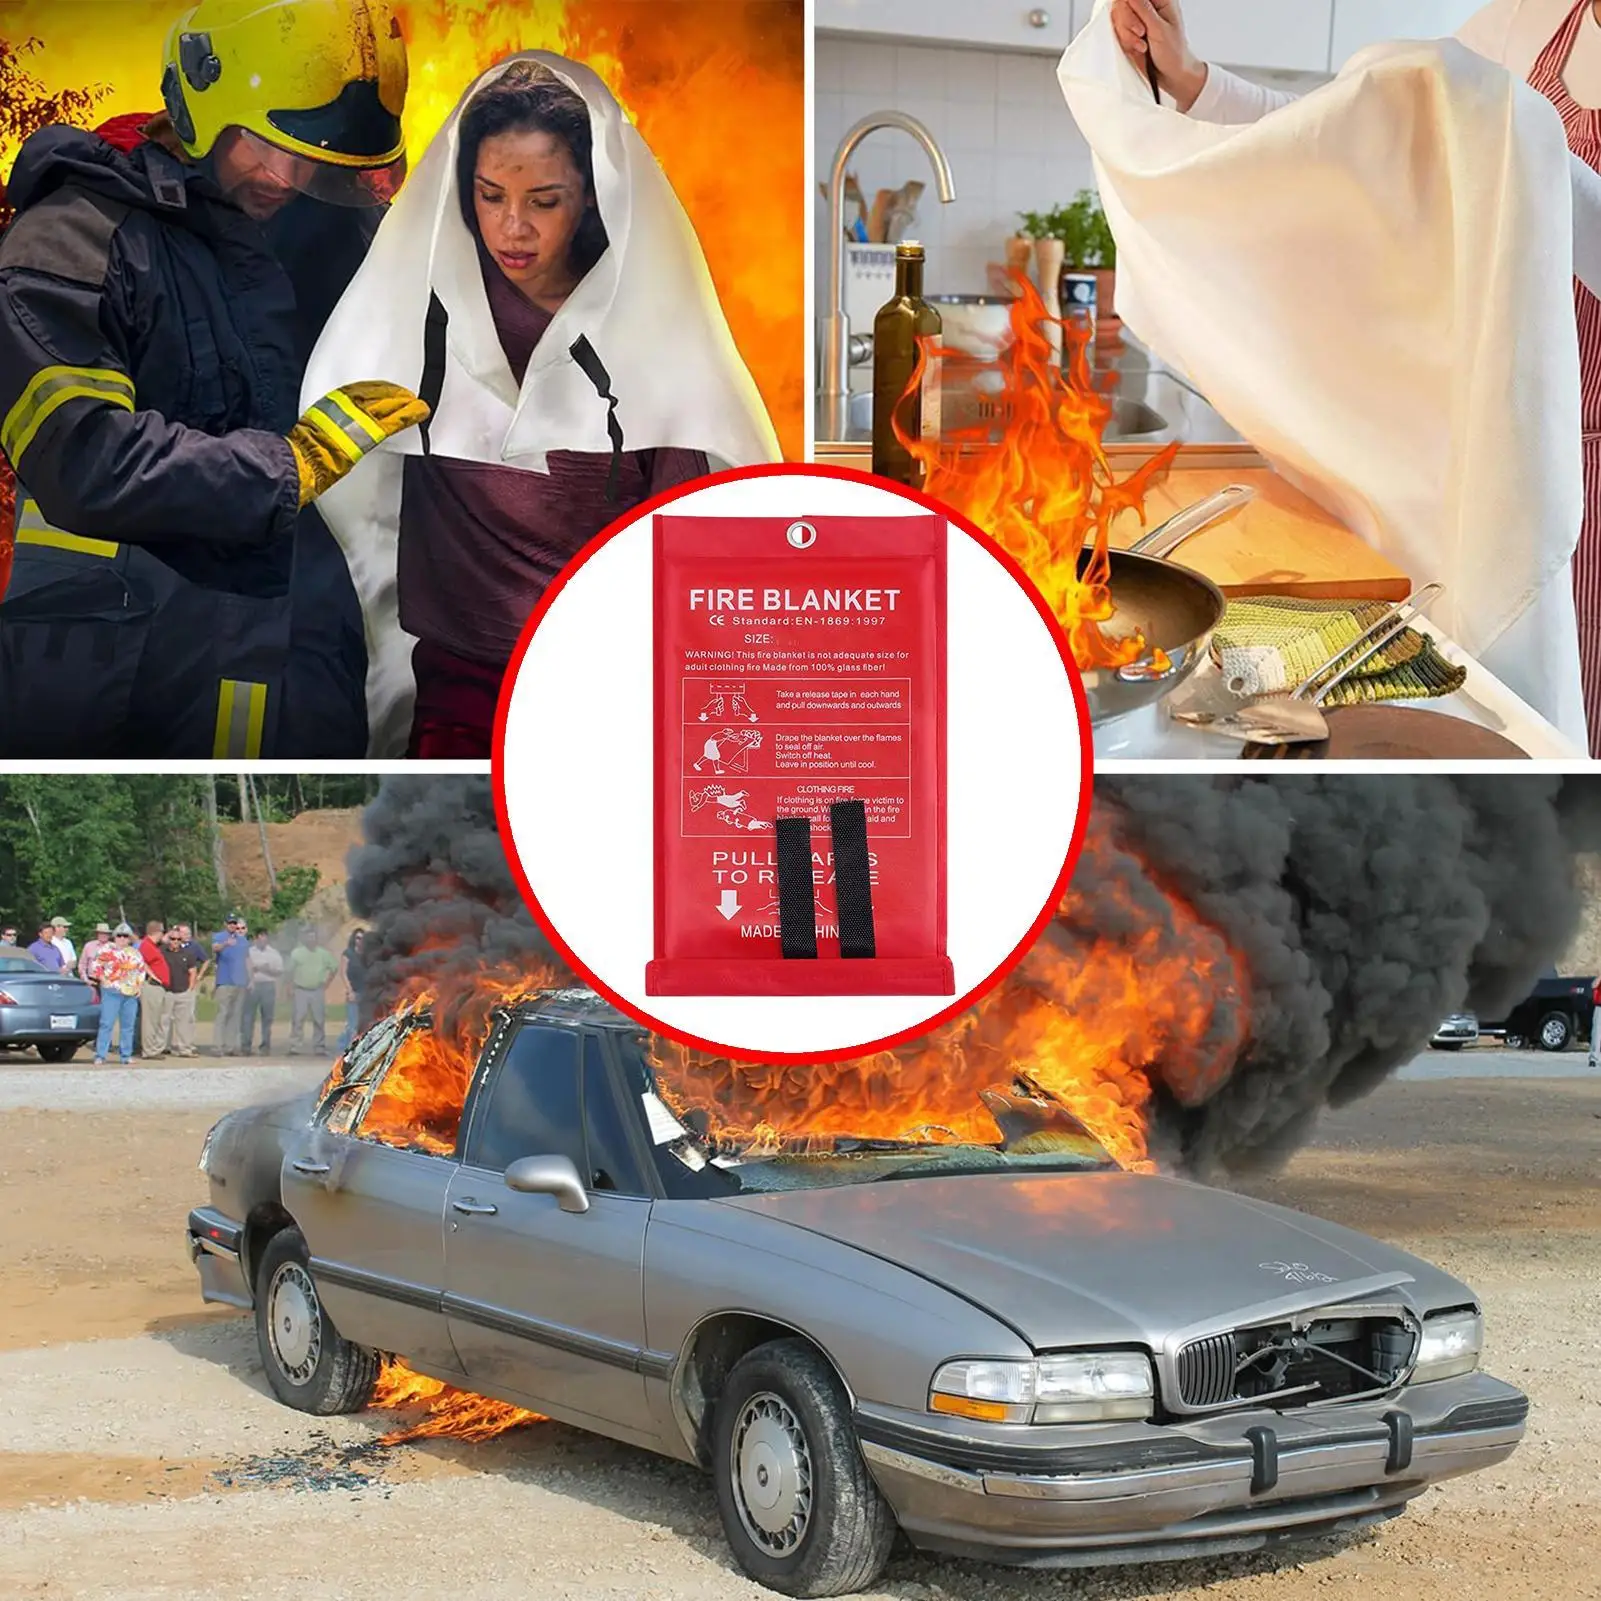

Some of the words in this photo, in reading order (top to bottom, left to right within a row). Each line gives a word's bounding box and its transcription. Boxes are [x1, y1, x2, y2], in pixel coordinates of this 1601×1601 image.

[689, 588, 755, 611] FIRE
[763, 588, 901, 611] BLANKET
[744, 633, 774, 644] SIZE:
[685, 650, 735, 659] WARNING!
[736, 650, 755, 659] This
[757, 650, 771, 659] fire
[772, 650, 806, 659] blanket
[807, 650, 816, 659] is
[817, 650, 832, 659] not
[833, 651, 875, 661] adequate
[876, 650, 895, 659] size
[896, 650, 909, 659] for
[746, 663, 761, 672] fire
[763, 663, 787, 672] Made
[788, 663, 808, 672] from
[811, 663, 835, 672] 100%
[837, 663, 861, 674] glass
[776, 690, 795, 699] Take
[796, 690, 801, 699] a
[802, 690, 830, 699] release
[831, 691, 849, 701] tape
[850, 690, 857, 699] in
[860, 690, 878, 699] each
[880, 690, 900, 699] hand
[776, 701, 790, 710] and
[791, 701, 806, 711] pull
[806, 701, 850, 710] downwards
[851, 701, 865, 710] and
[867, 701, 902, 710] outwards
[776, 734, 799, 743] Drape
[801, 734, 813, 743] the
[814, 734, 843, 743] blanket
[844, 734, 861, 743] over
[862, 734, 875, 743] the
[876, 734, 902, 743] flames
[776, 743, 783, 751] to
[785, 743, 801, 751] seal
[802, 743, 813, 751] off
[776, 751, 801, 760] Switch
[802, 751, 813, 760] off
[776, 760, 799, 769] Leave
[801, 760, 807, 769] in
[808, 760, 840, 770] position
[841, 760, 856, 769] until
[796, 785, 836, 794] CLOTHING
[838, 785, 855, 794] FIRE
[776, 796, 783, 804] If
[784, 796, 814, 806] clothing
[815, 796, 823, 804] is
[824, 796, 834, 804] on
[872, 796, 895, 804] victim
[896, 796, 904, 804] to
[776, 804, 789, 814] the
[873, 804, 886, 814] the
[887, 804, 900, 814] fire
[881, 813, 896, 823] and
[712, 851, 779, 867] PULL
[711, 869, 749, 886] TO
[740, 923, 782, 939] MADE
